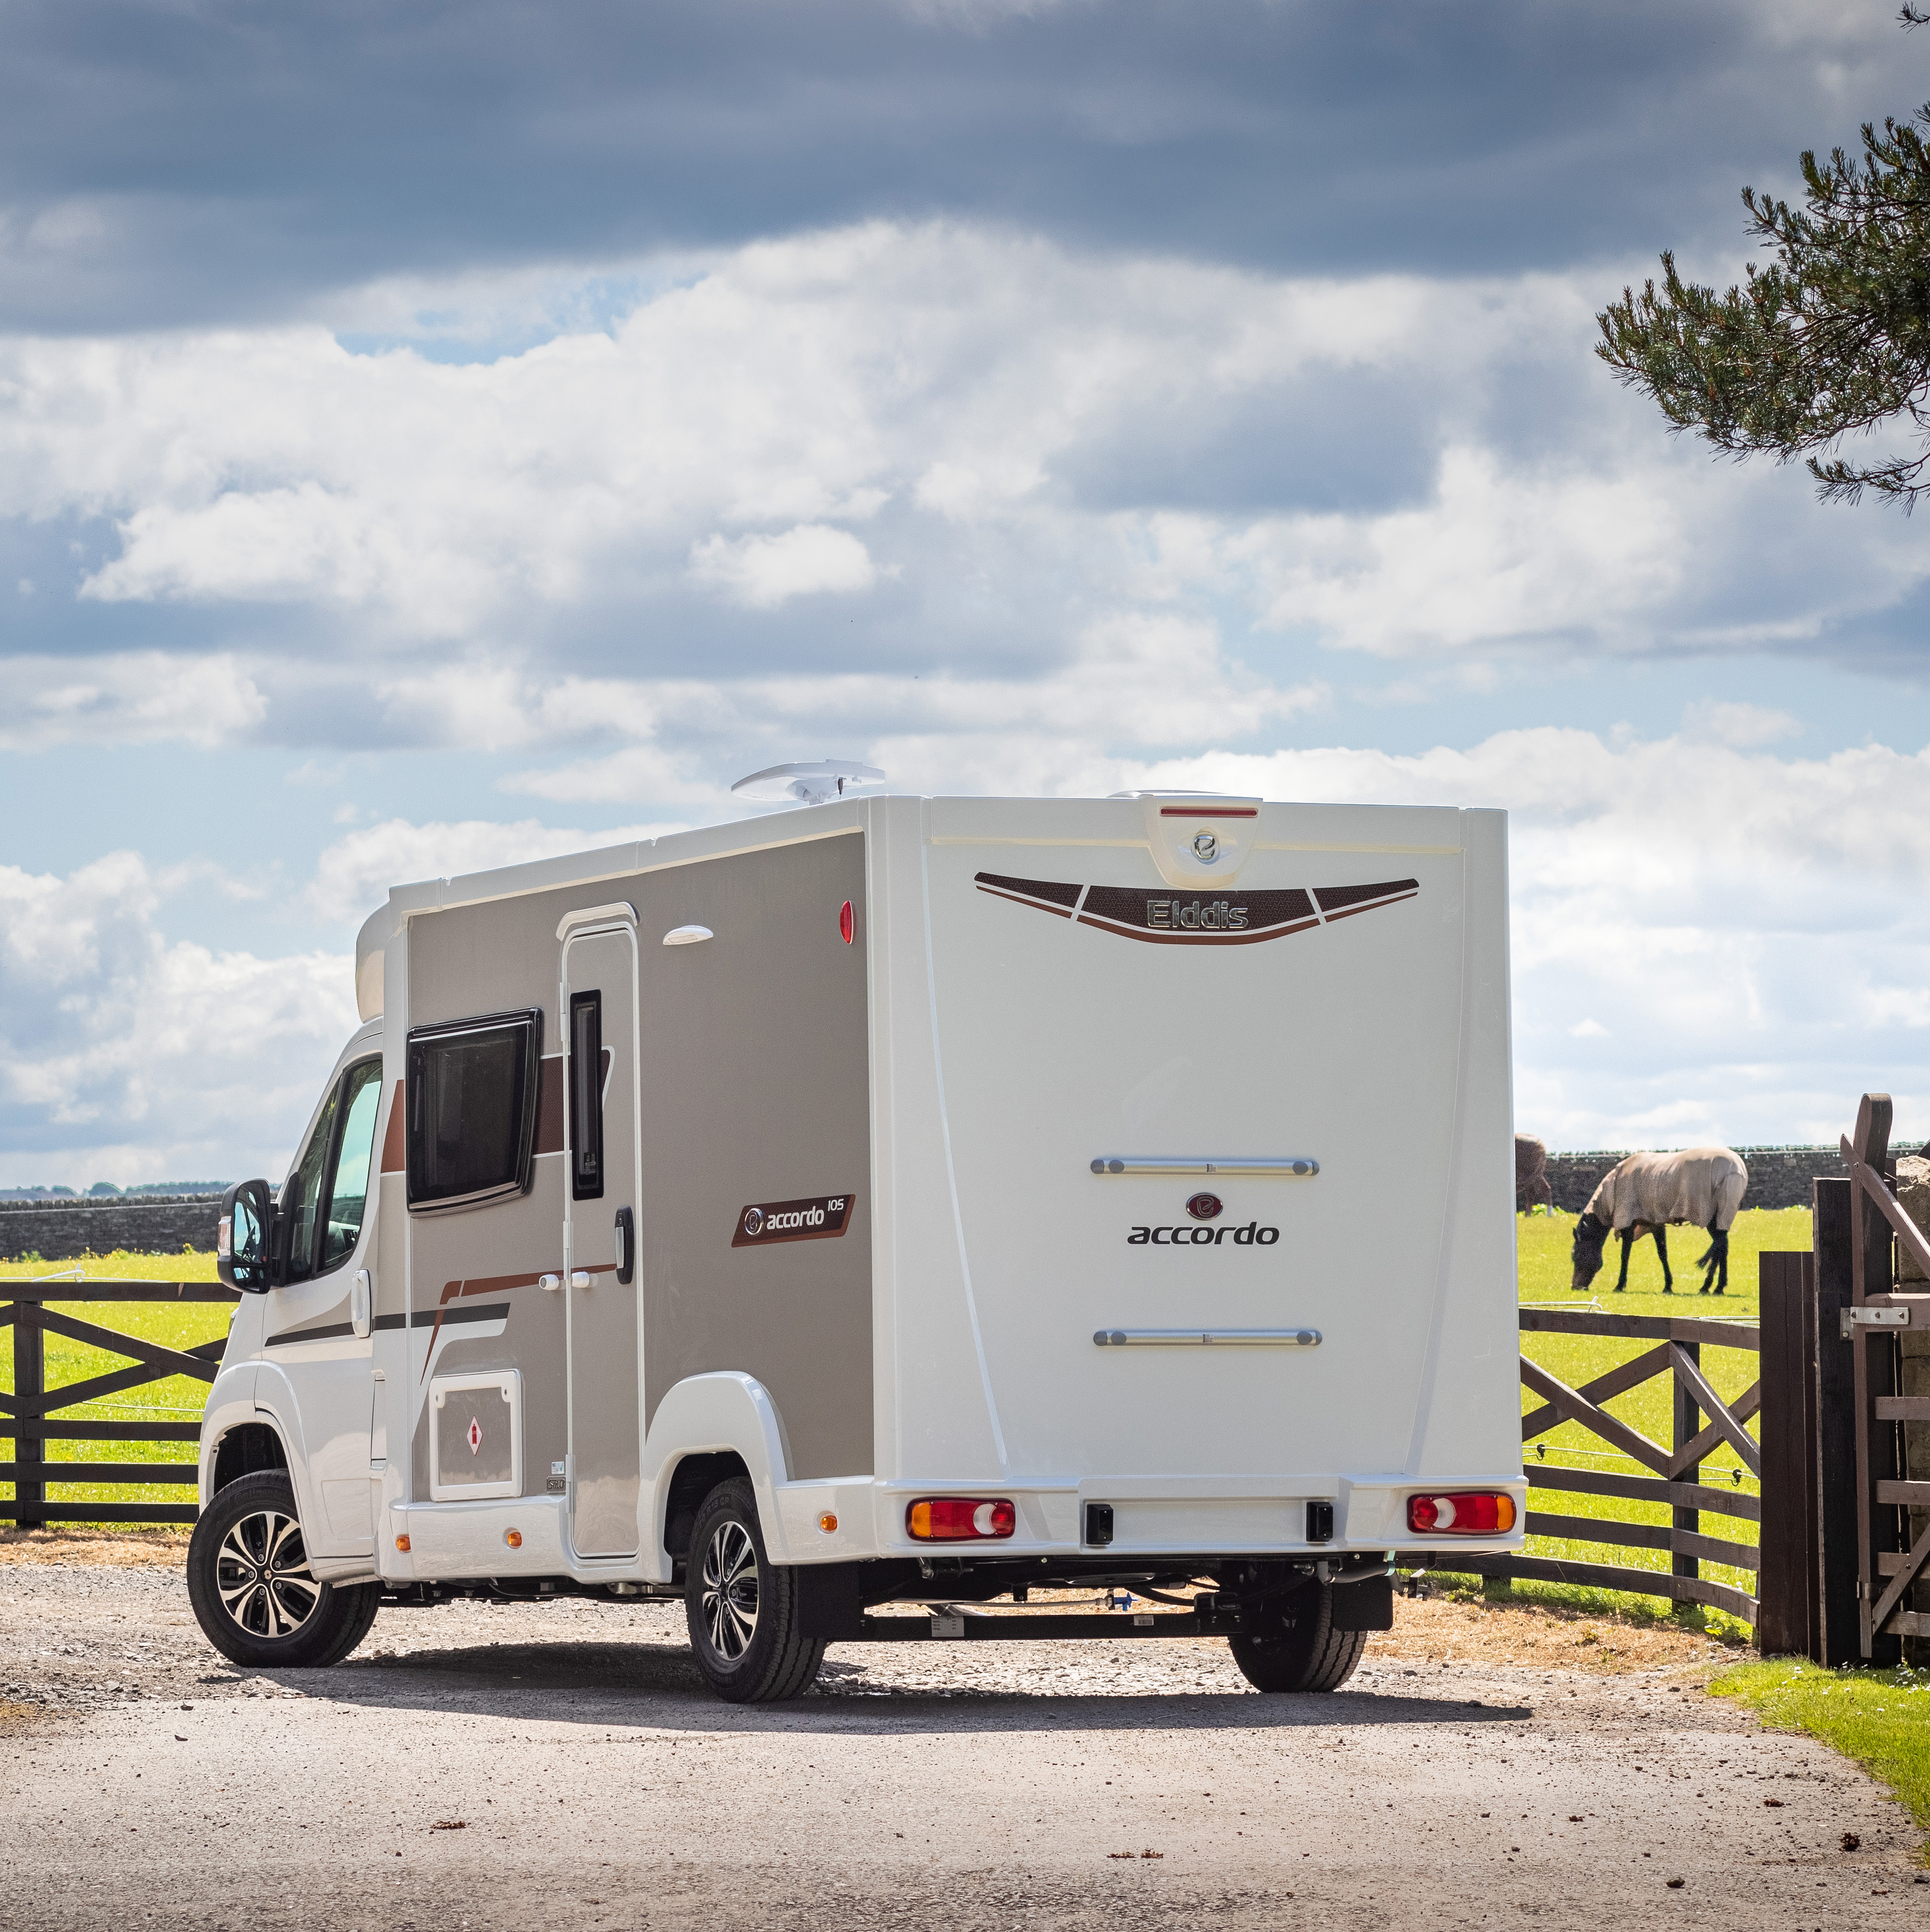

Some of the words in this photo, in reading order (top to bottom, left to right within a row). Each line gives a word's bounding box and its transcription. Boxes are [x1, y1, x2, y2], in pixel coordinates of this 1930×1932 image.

[1147, 900, 1249, 928] Elddis
[767, 1205, 824, 1230] accordo
[828, 1198, 844, 1211] 105
[1127, 1221, 1280, 1245] accordo
